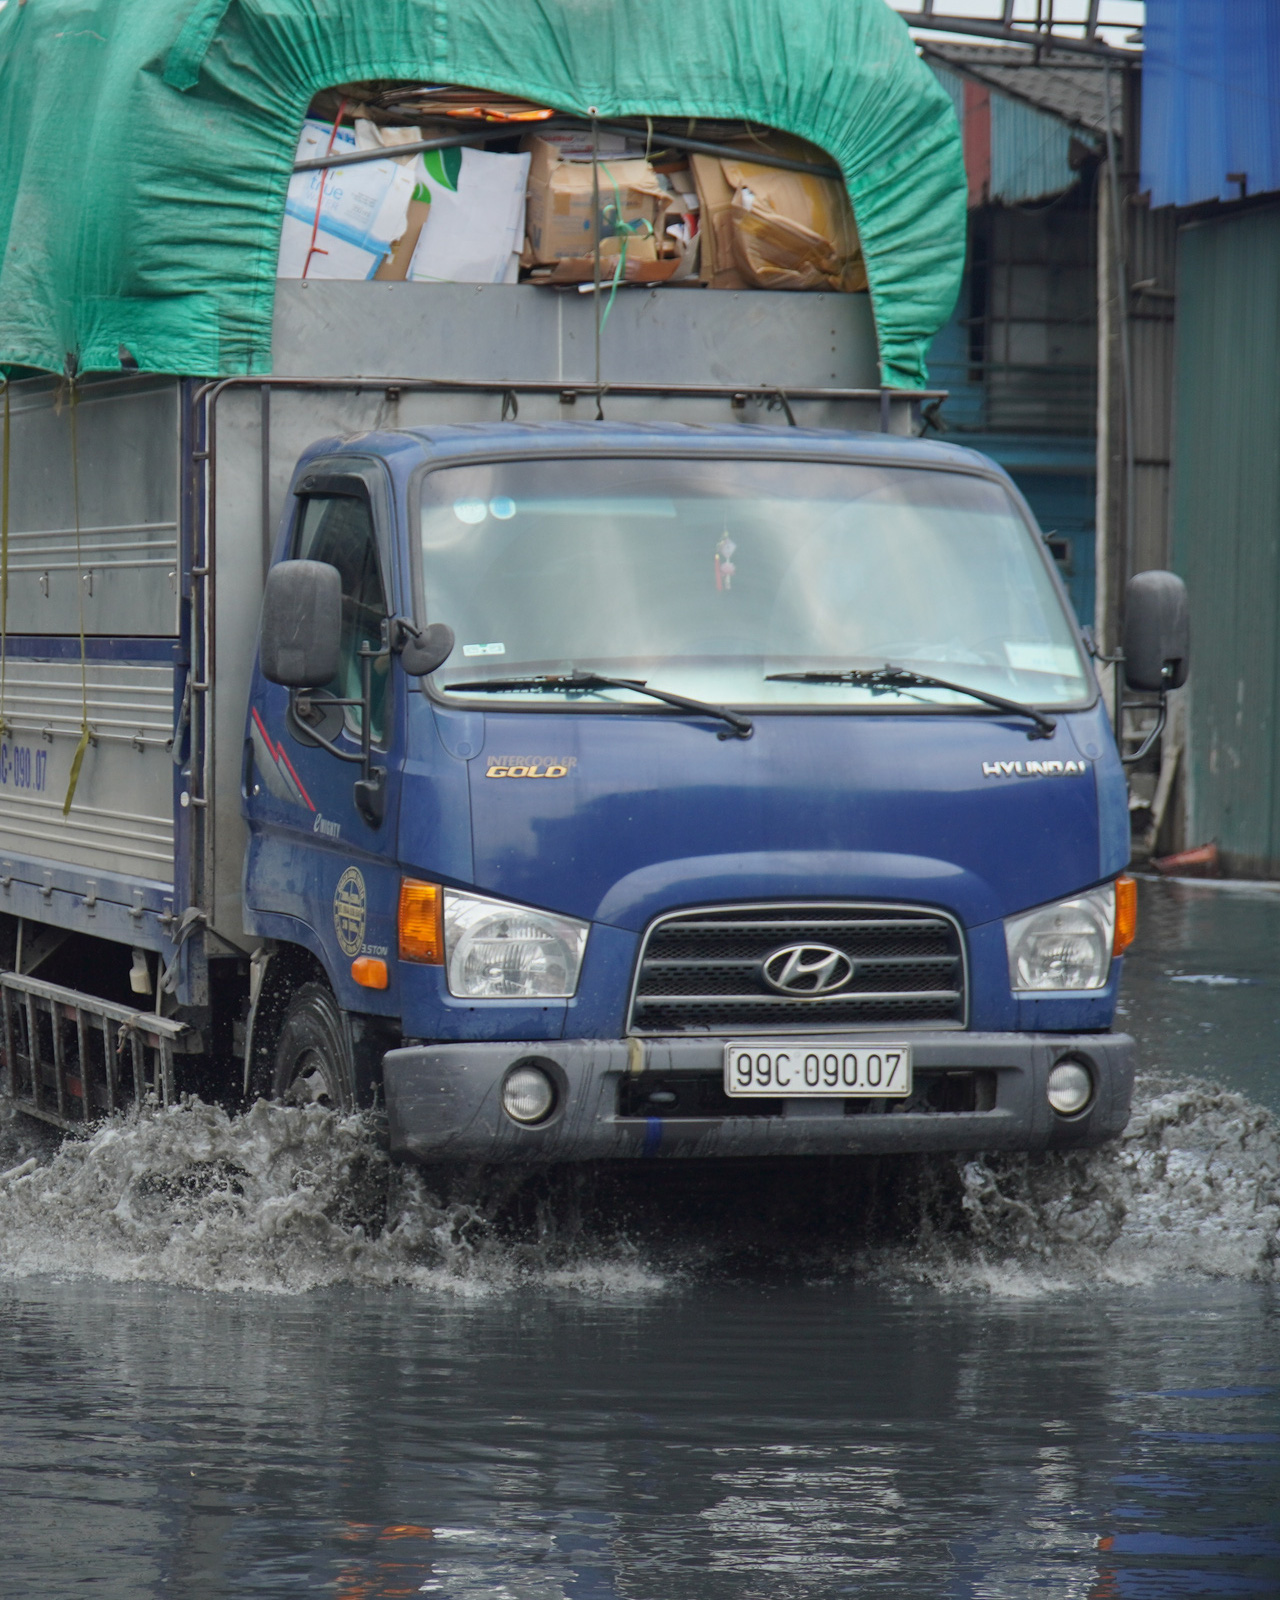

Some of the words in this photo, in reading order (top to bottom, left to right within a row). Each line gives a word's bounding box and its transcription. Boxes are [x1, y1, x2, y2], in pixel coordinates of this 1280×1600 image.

[310, 175, 344, 200] true
[487, 755, 578, 768] INTERCOOLER
[982, 760, 1086, 778] HYUNDAI
[485, 765, 568, 778] GOLD
[736, 1053, 901, 1087] 99C-090.07
